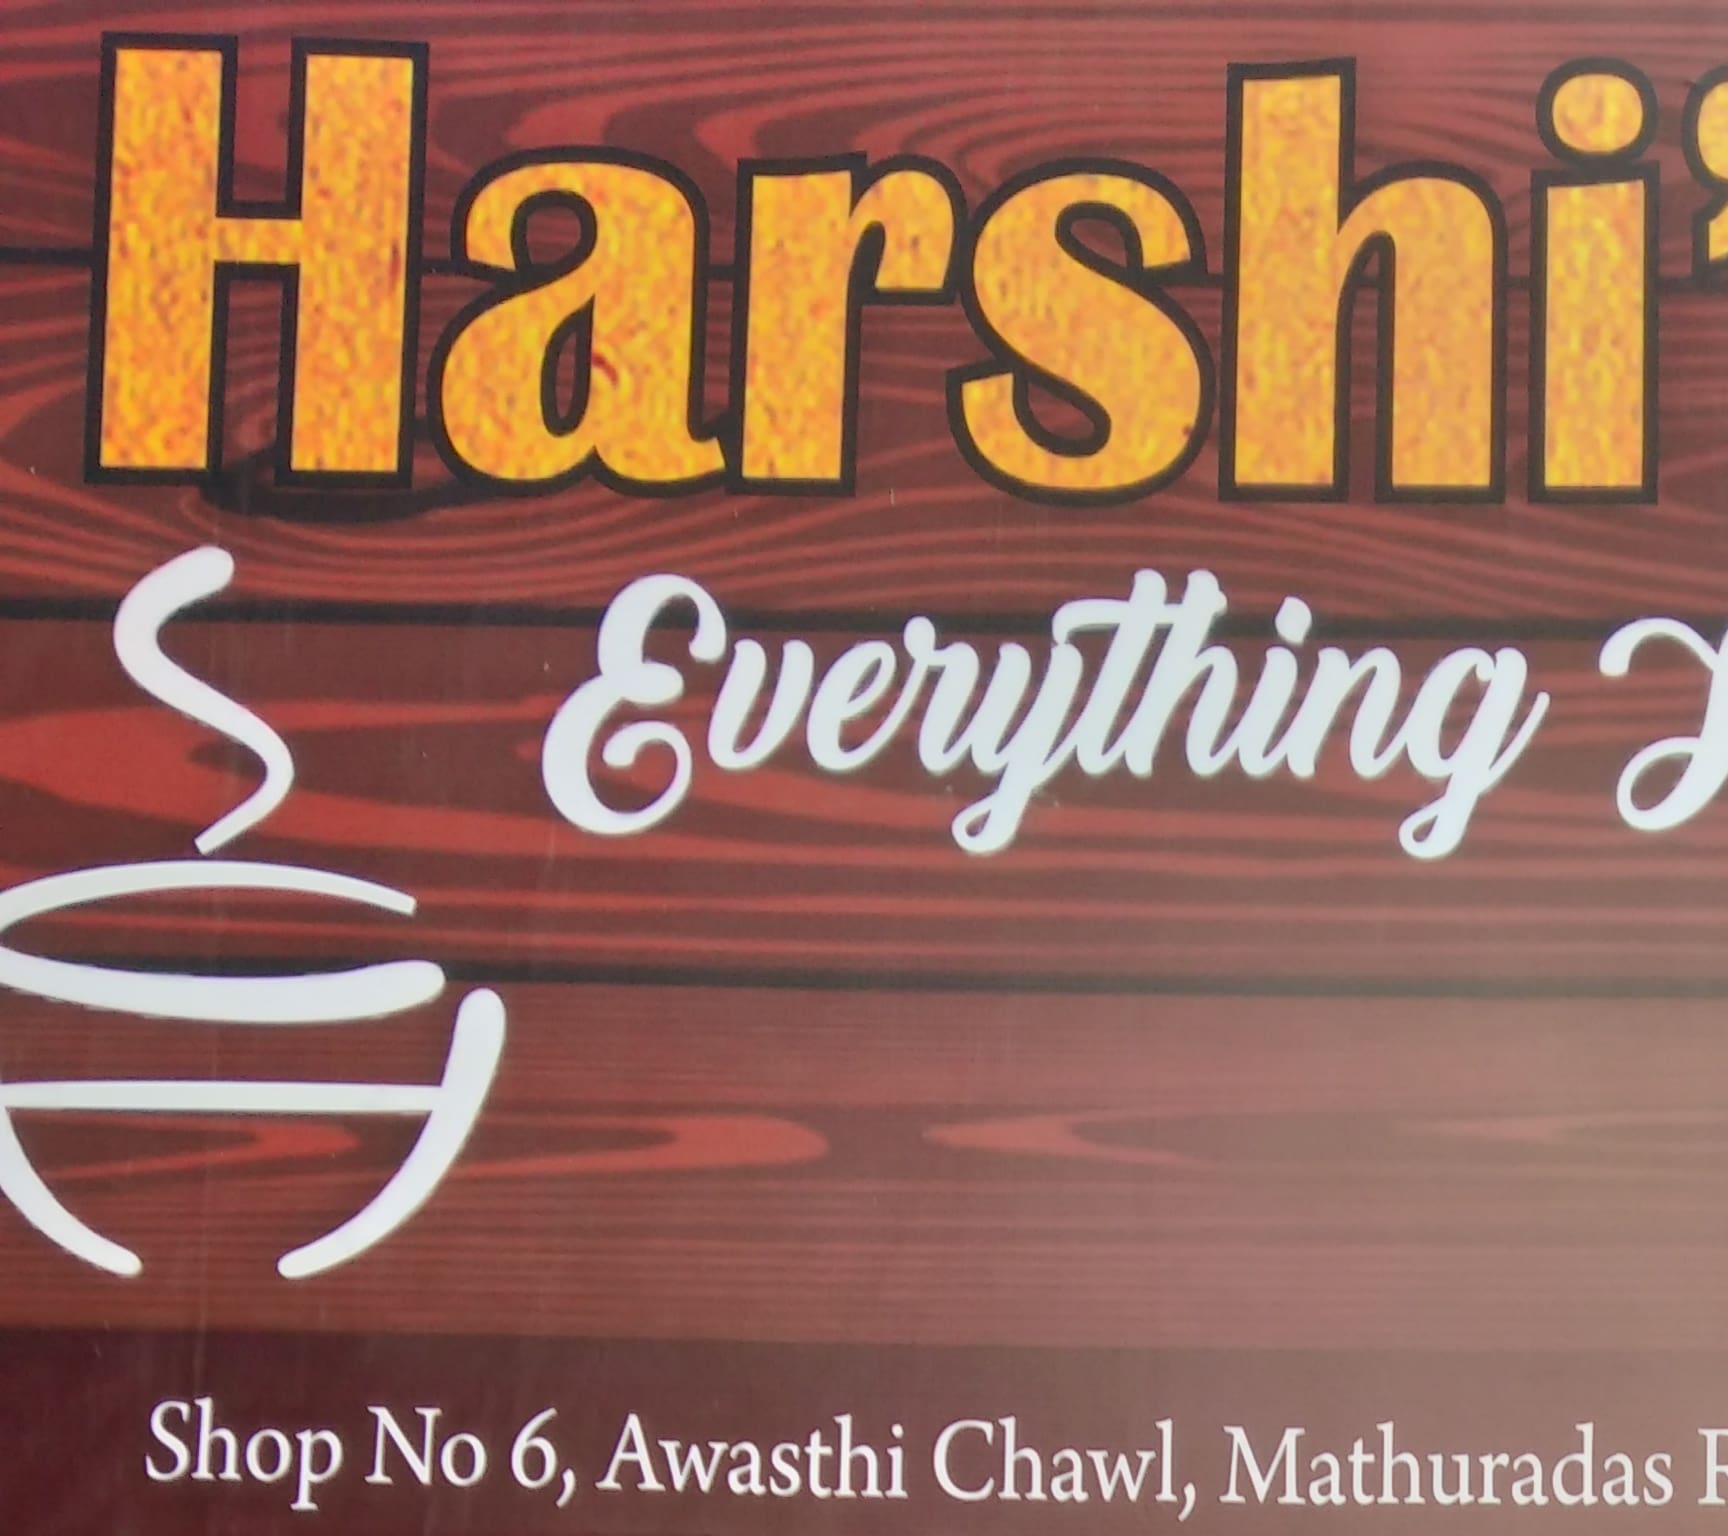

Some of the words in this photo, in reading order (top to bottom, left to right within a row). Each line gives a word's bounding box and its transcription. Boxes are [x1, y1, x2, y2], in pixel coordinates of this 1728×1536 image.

[541, 568, 1550, 860] Everything
[144, 1396, 344, 1511] Shop
[365, 1406, 487, 1488] No
[511, 1407, 576, 1508] 6,
[596, 1413, 908, 1499] Awasthi
[933, 1415, 1196, 1521] Chawl,
[1219, 1421, 1674, 1506] Mathuradas
